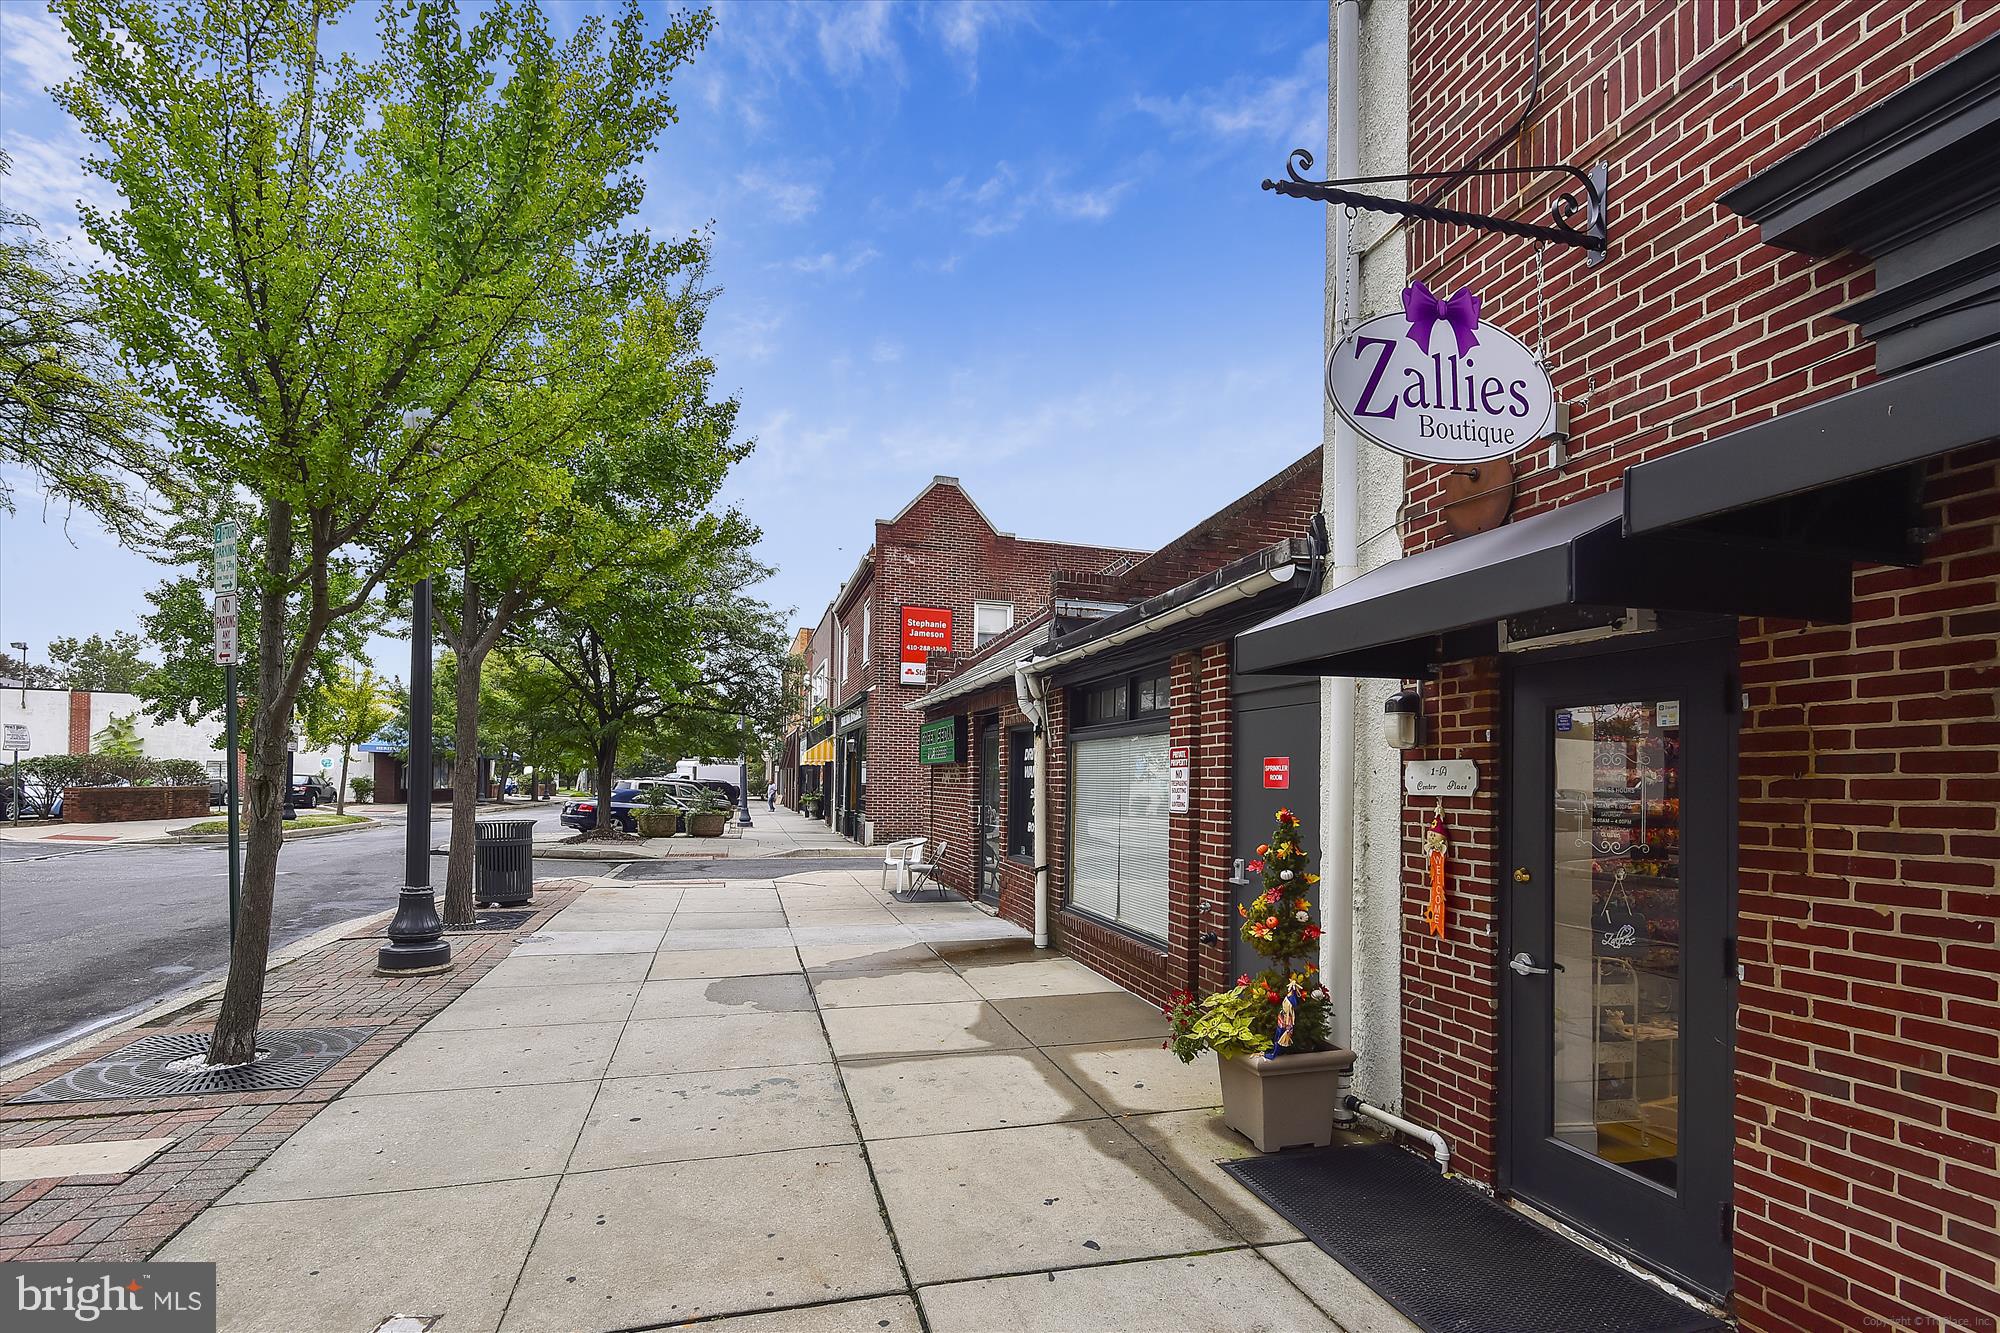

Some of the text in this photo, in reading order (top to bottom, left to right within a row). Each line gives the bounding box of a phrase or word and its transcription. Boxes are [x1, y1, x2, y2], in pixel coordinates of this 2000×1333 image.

[1353, 335, 1530, 420] Zallies
[1418, 414, 1515, 447] Boutique
[216, 525, 235, 541] 2 HOUR
[216, 543, 235, 558] PARKING
[222, 599, 230, 613] NO
[216, 615, 235, 629] PARKING
[907, 618, 947, 629] Stephanie
[222, 630, 230, 639] ANY
[909, 629, 945, 638] Jameson
[222, 641, 231, 649] TIME
[921, 724, 954, 746] GREEN SEDAN
[1172, 751, 1186, 759] PRIVATE
[1170, 759, 1188, 767] PROPERTY
[1175, 770, 1182, 779] NO
[1431, 766, 1447, 776] 1-A
[1417, 780, 1468, 790] Center Place
[1433, 856, 1441, 923] WELCOME
